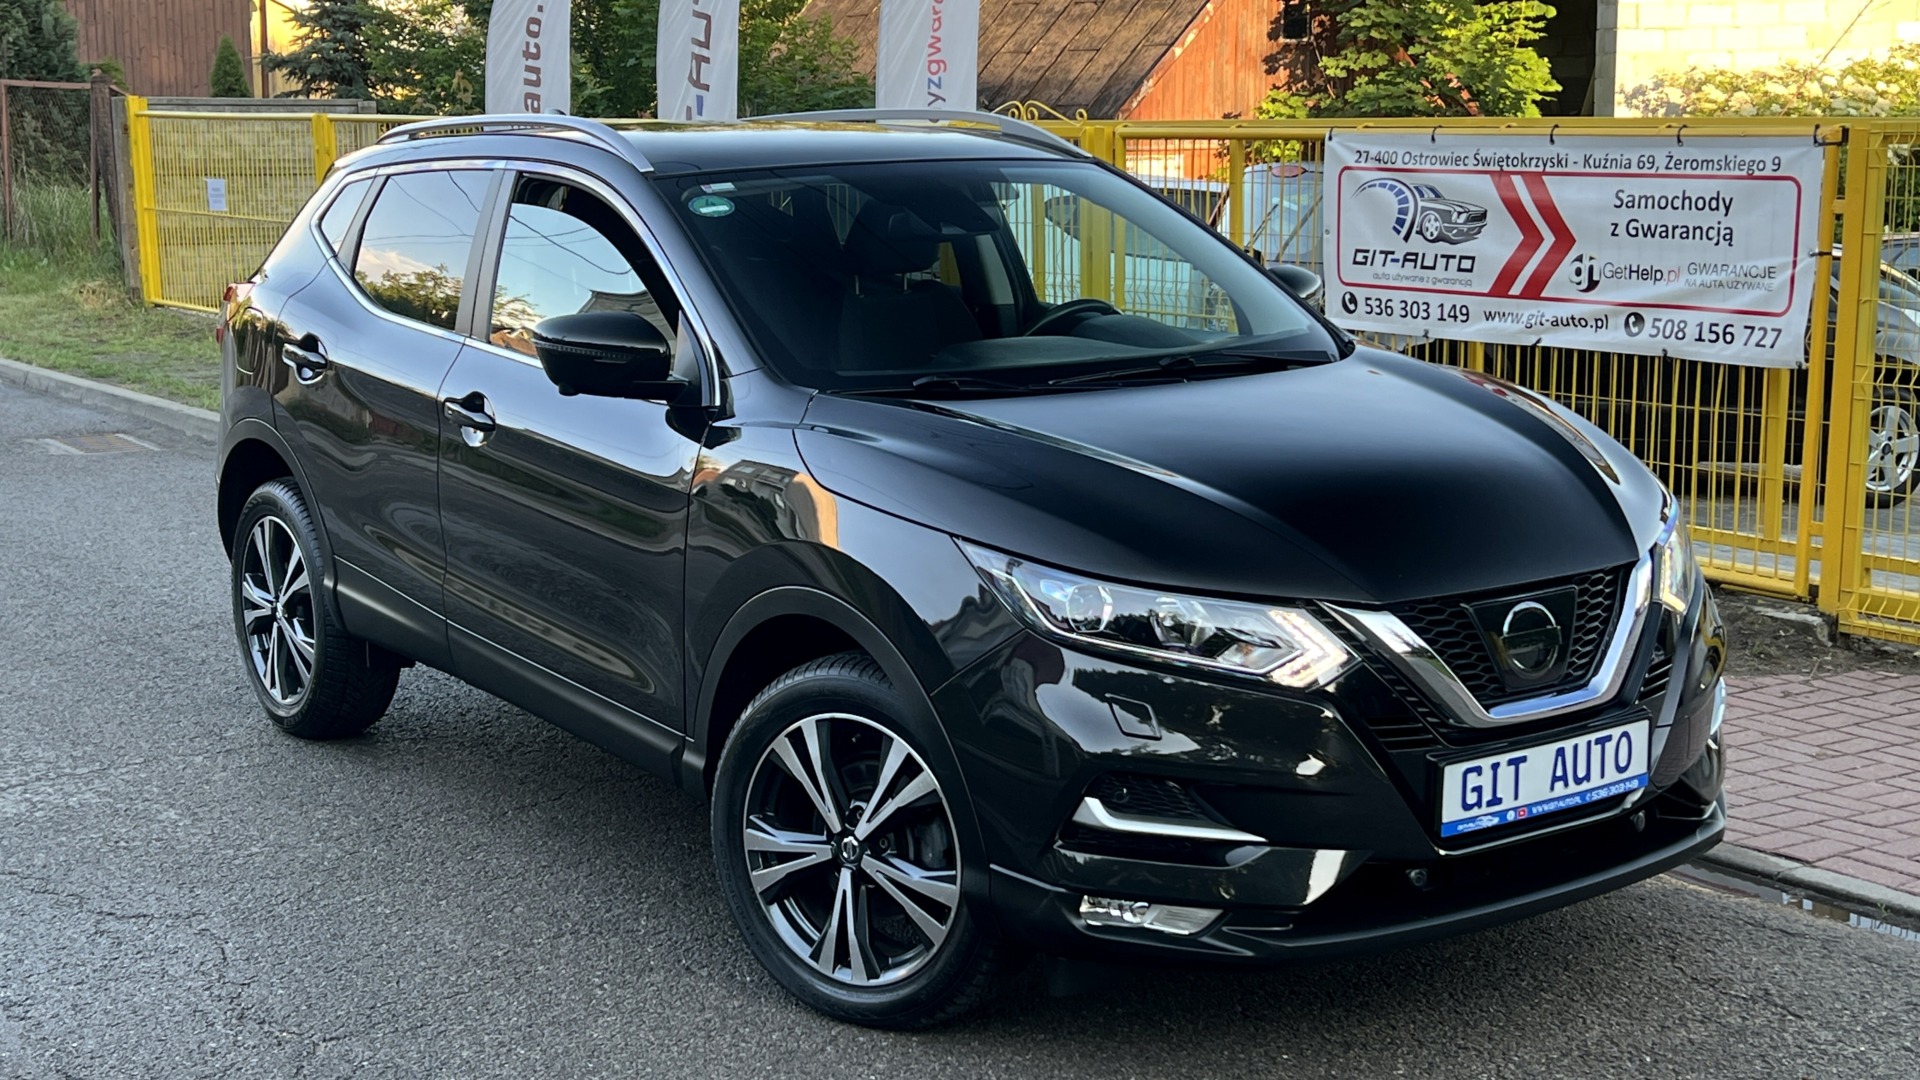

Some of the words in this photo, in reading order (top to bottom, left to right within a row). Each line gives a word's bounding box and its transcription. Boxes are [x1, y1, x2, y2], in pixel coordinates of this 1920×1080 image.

[927, 0, 948, 123] yzgwar
[1354, 150, 1398, 165] 27-400
[1401, 151, 1469, 167] Ostrowiec
[1473, 149, 1569, 172] Świętokrzyski
[1583, 152, 1632, 170] Kuźnia
[1637, 154, 1660, 173] 69,
[1664, 151, 1766, 175] Żeromskiego
[1771, 156, 1781, 172] 9
[1613, 188, 1734, 217] Samochody
[1610, 222, 1619, 237] z
[1625, 218, 1734, 247] Gwarancją
[1352, 248, 1476, 273] GIT-AUTO
[1602, 261, 1681, 286] GetHelp.pl
[1687, 261, 1777, 279] GWARANCJE
[1372, 272, 1390, 281] auta
[1684, 279, 1698, 288] NA
[1699, 279, 1725, 289] AUTA
[1364, 297, 1394, 317] 536
[1399, 300, 1431, 320] 303
[1437, 303, 1470, 323] 149
[1483, 308, 1609, 333] www.git-auto.pl
[1648, 317, 1687, 341] 508
[1694, 321, 1735, 345] 156
[1742, 325, 1783, 349] 727
[1461, 755, 1527, 812] GIT
[1550, 730, 1633, 792] AUTO
